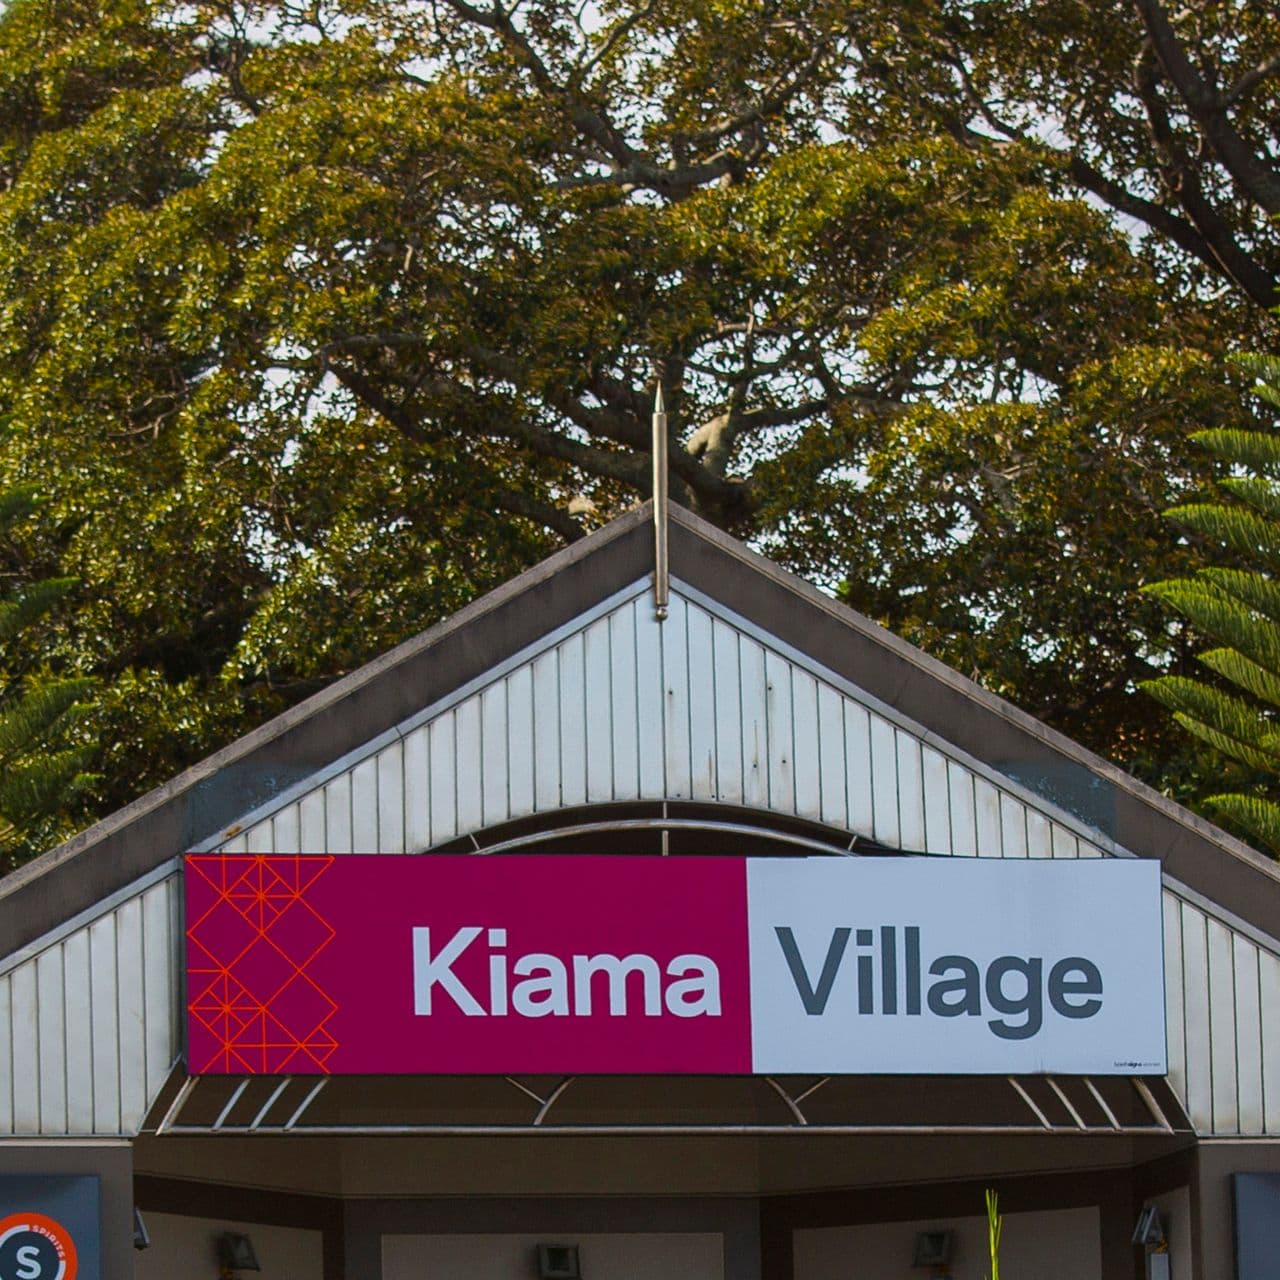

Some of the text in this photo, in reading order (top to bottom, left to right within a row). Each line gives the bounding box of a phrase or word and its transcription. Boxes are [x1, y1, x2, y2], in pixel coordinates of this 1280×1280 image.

[411, 925, 1105, 1042] Kiama Village
[32, 1224, 66, 1261] SPIRITS
